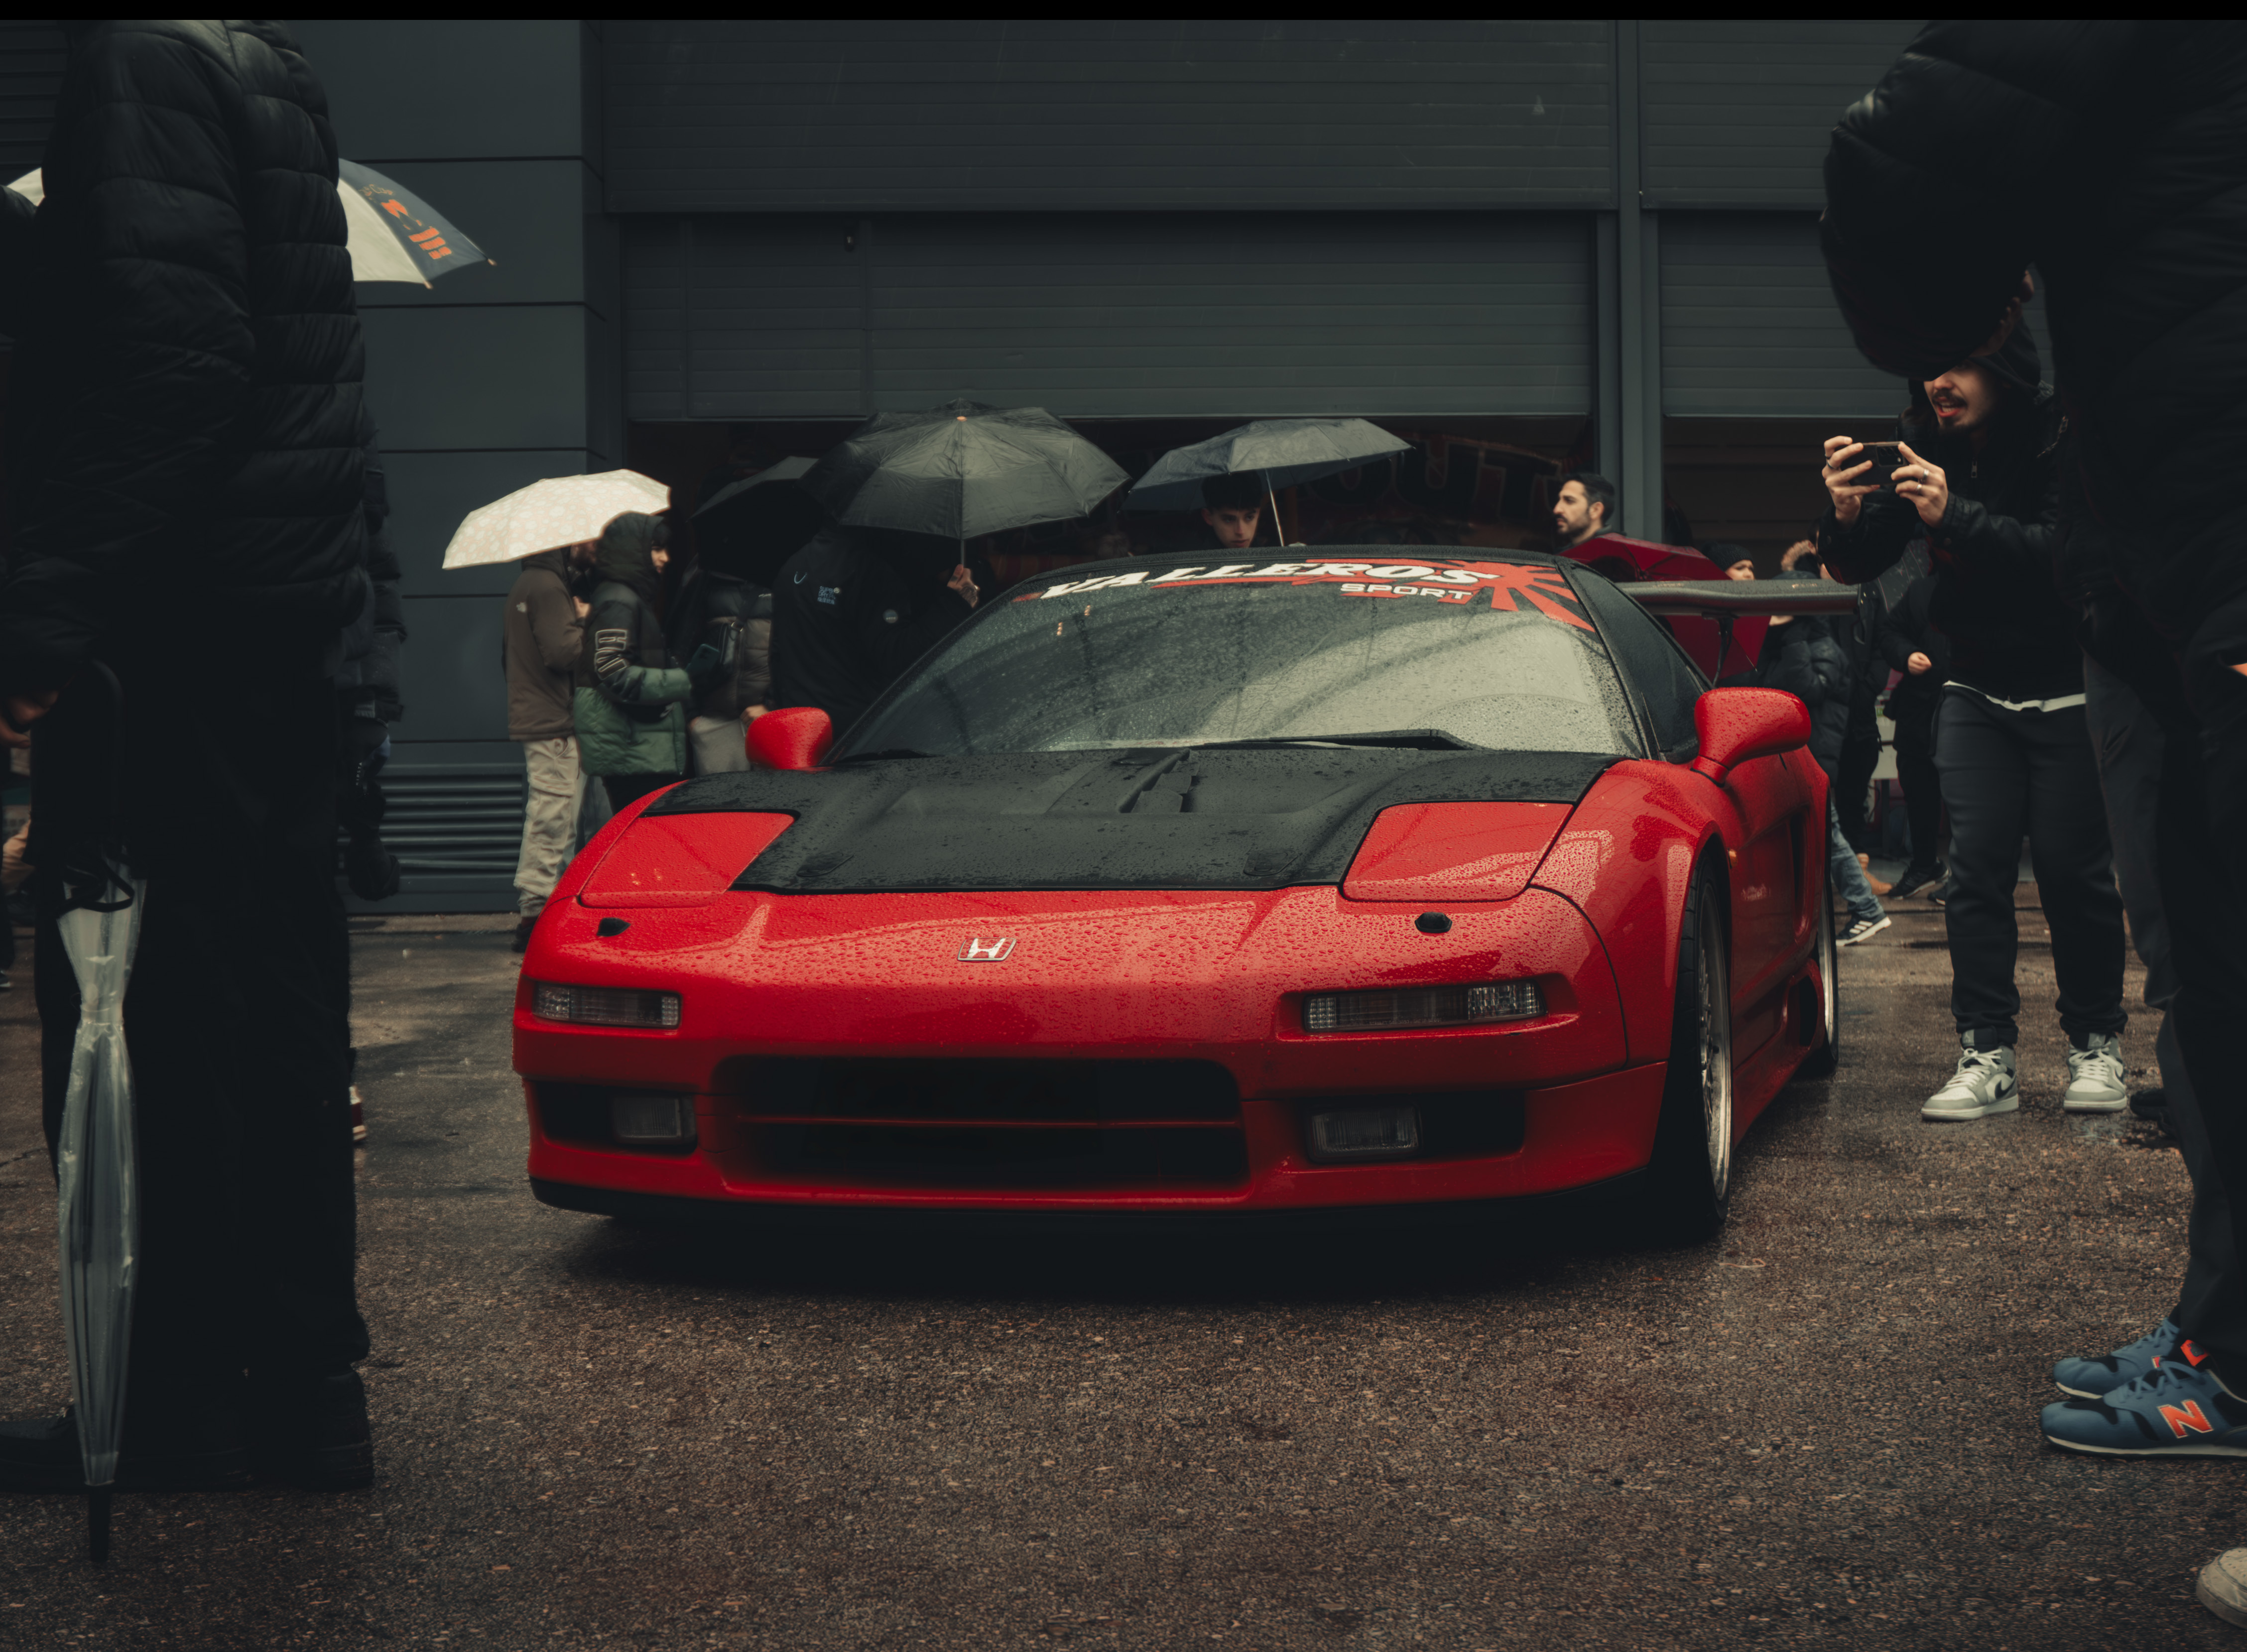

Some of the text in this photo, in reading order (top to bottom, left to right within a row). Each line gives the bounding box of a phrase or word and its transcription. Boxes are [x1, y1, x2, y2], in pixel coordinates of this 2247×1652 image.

[1040, 563, 1502, 599] VALLEROS
[1340, 583, 1473, 600] SPORT
[2157, 1399, 2215, 1439] N
